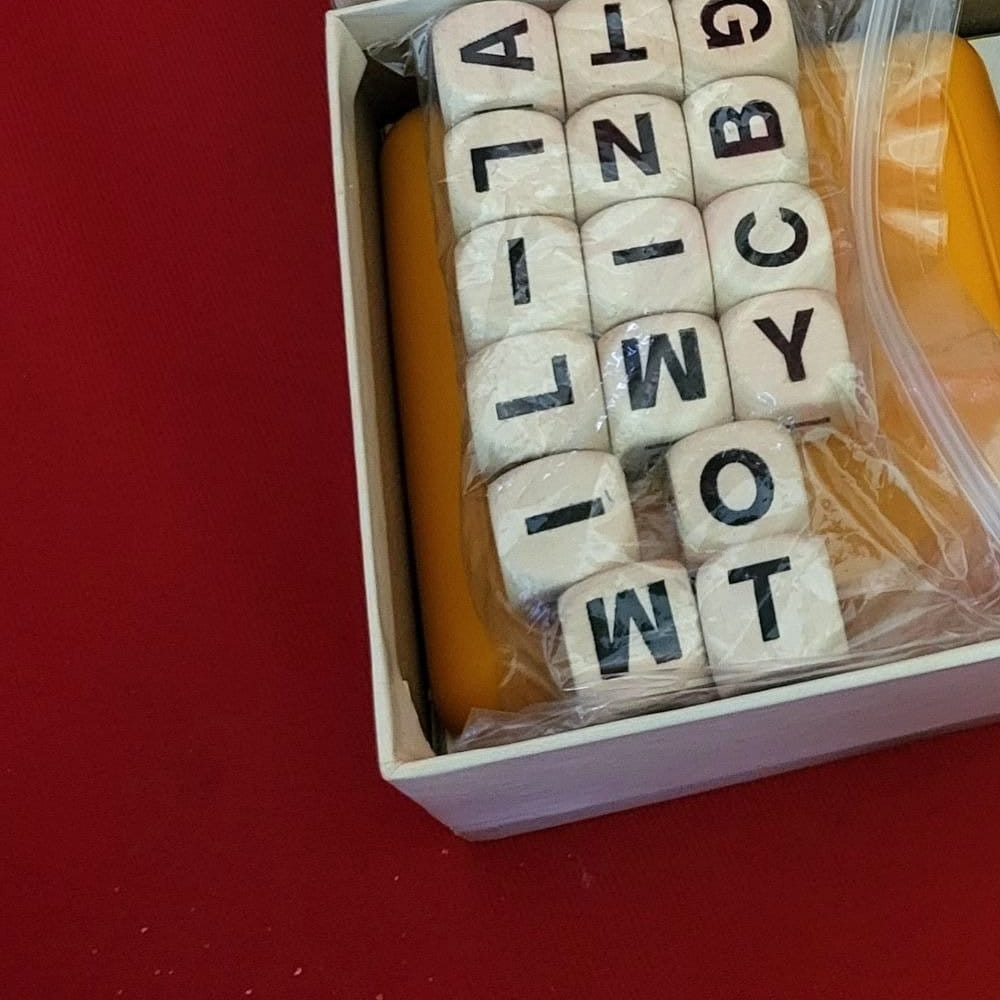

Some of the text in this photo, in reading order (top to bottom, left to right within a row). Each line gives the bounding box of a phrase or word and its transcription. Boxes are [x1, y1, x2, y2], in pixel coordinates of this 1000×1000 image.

[459, 19, 534, 71] A
[591, 3, 648, 66] T
[470, 139, 544, 193] L
[709, 100, 785, 159] B
[735, 207, 808, 267] C
[496, 355, 574, 420] L
[753, 308, 814, 382] Y
[700, 449, 774, 526] O
[728, 556, 791, 642] T
